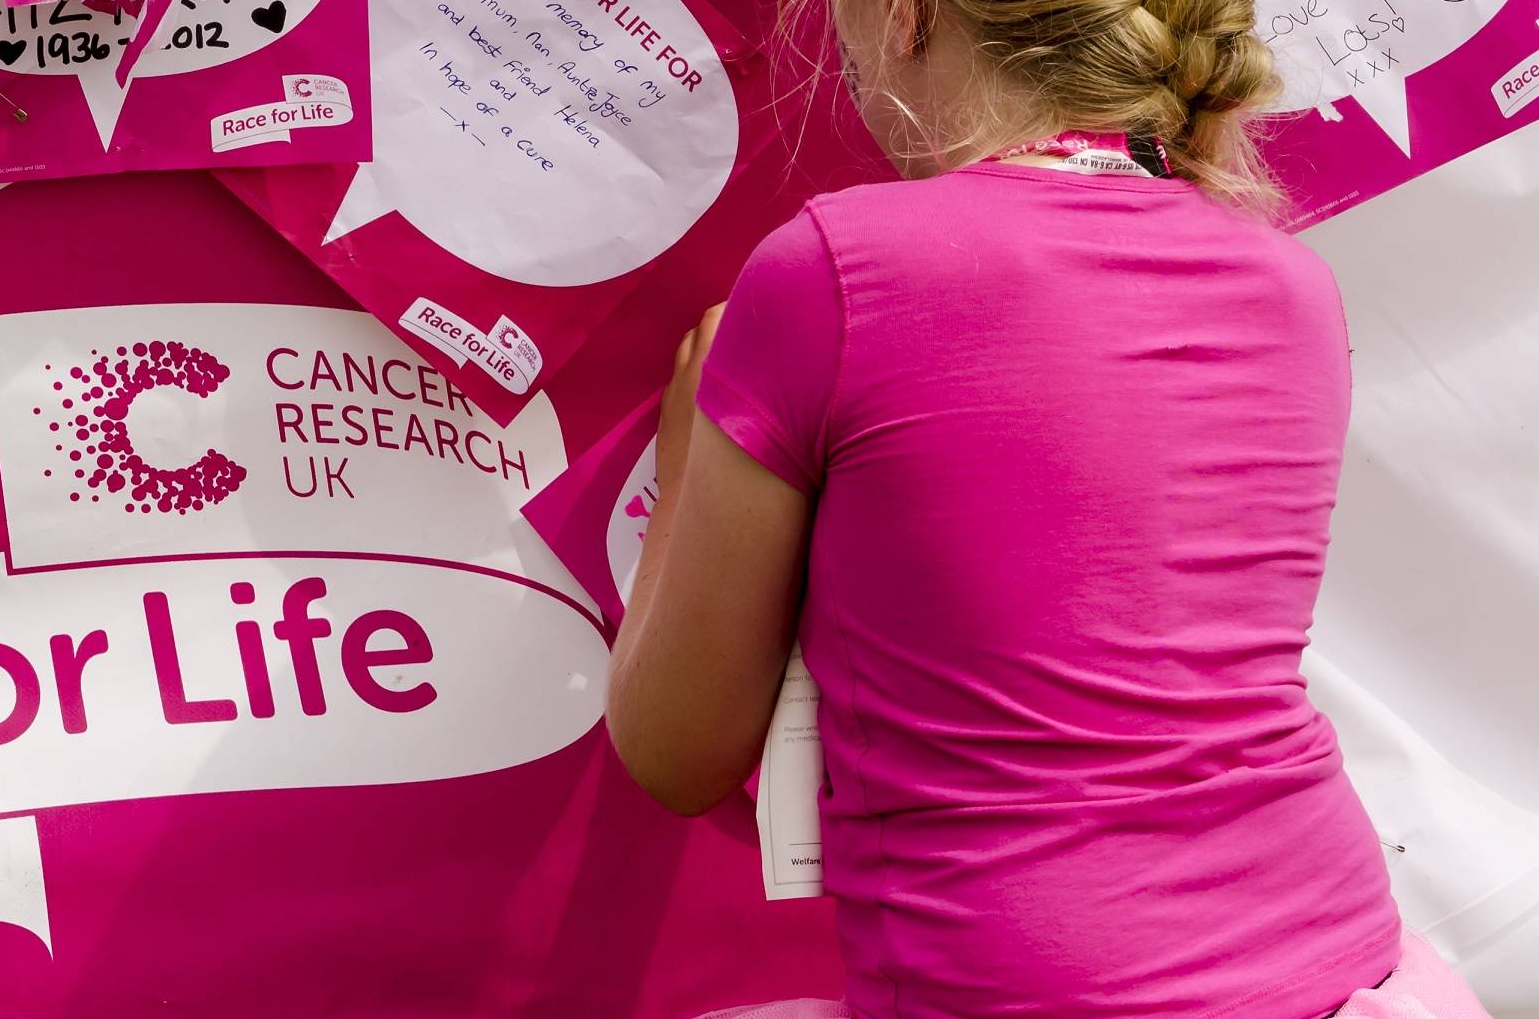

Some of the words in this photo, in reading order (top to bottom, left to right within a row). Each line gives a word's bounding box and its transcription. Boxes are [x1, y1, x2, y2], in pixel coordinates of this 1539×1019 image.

[468, 25, 502, 60] best
[614, 5, 661, 53] LIFE
[655, 44, 703, 93] FOR
[439, 61, 472, 96] hope
[221, 115, 267, 136] Race
[271, 107, 298, 126] for
[300, 103, 335, 123] Life
[274, 401, 531, 491] RESEARCH
[282, 455, 357, 500] UK
[142, 575, 439, 726] Life
